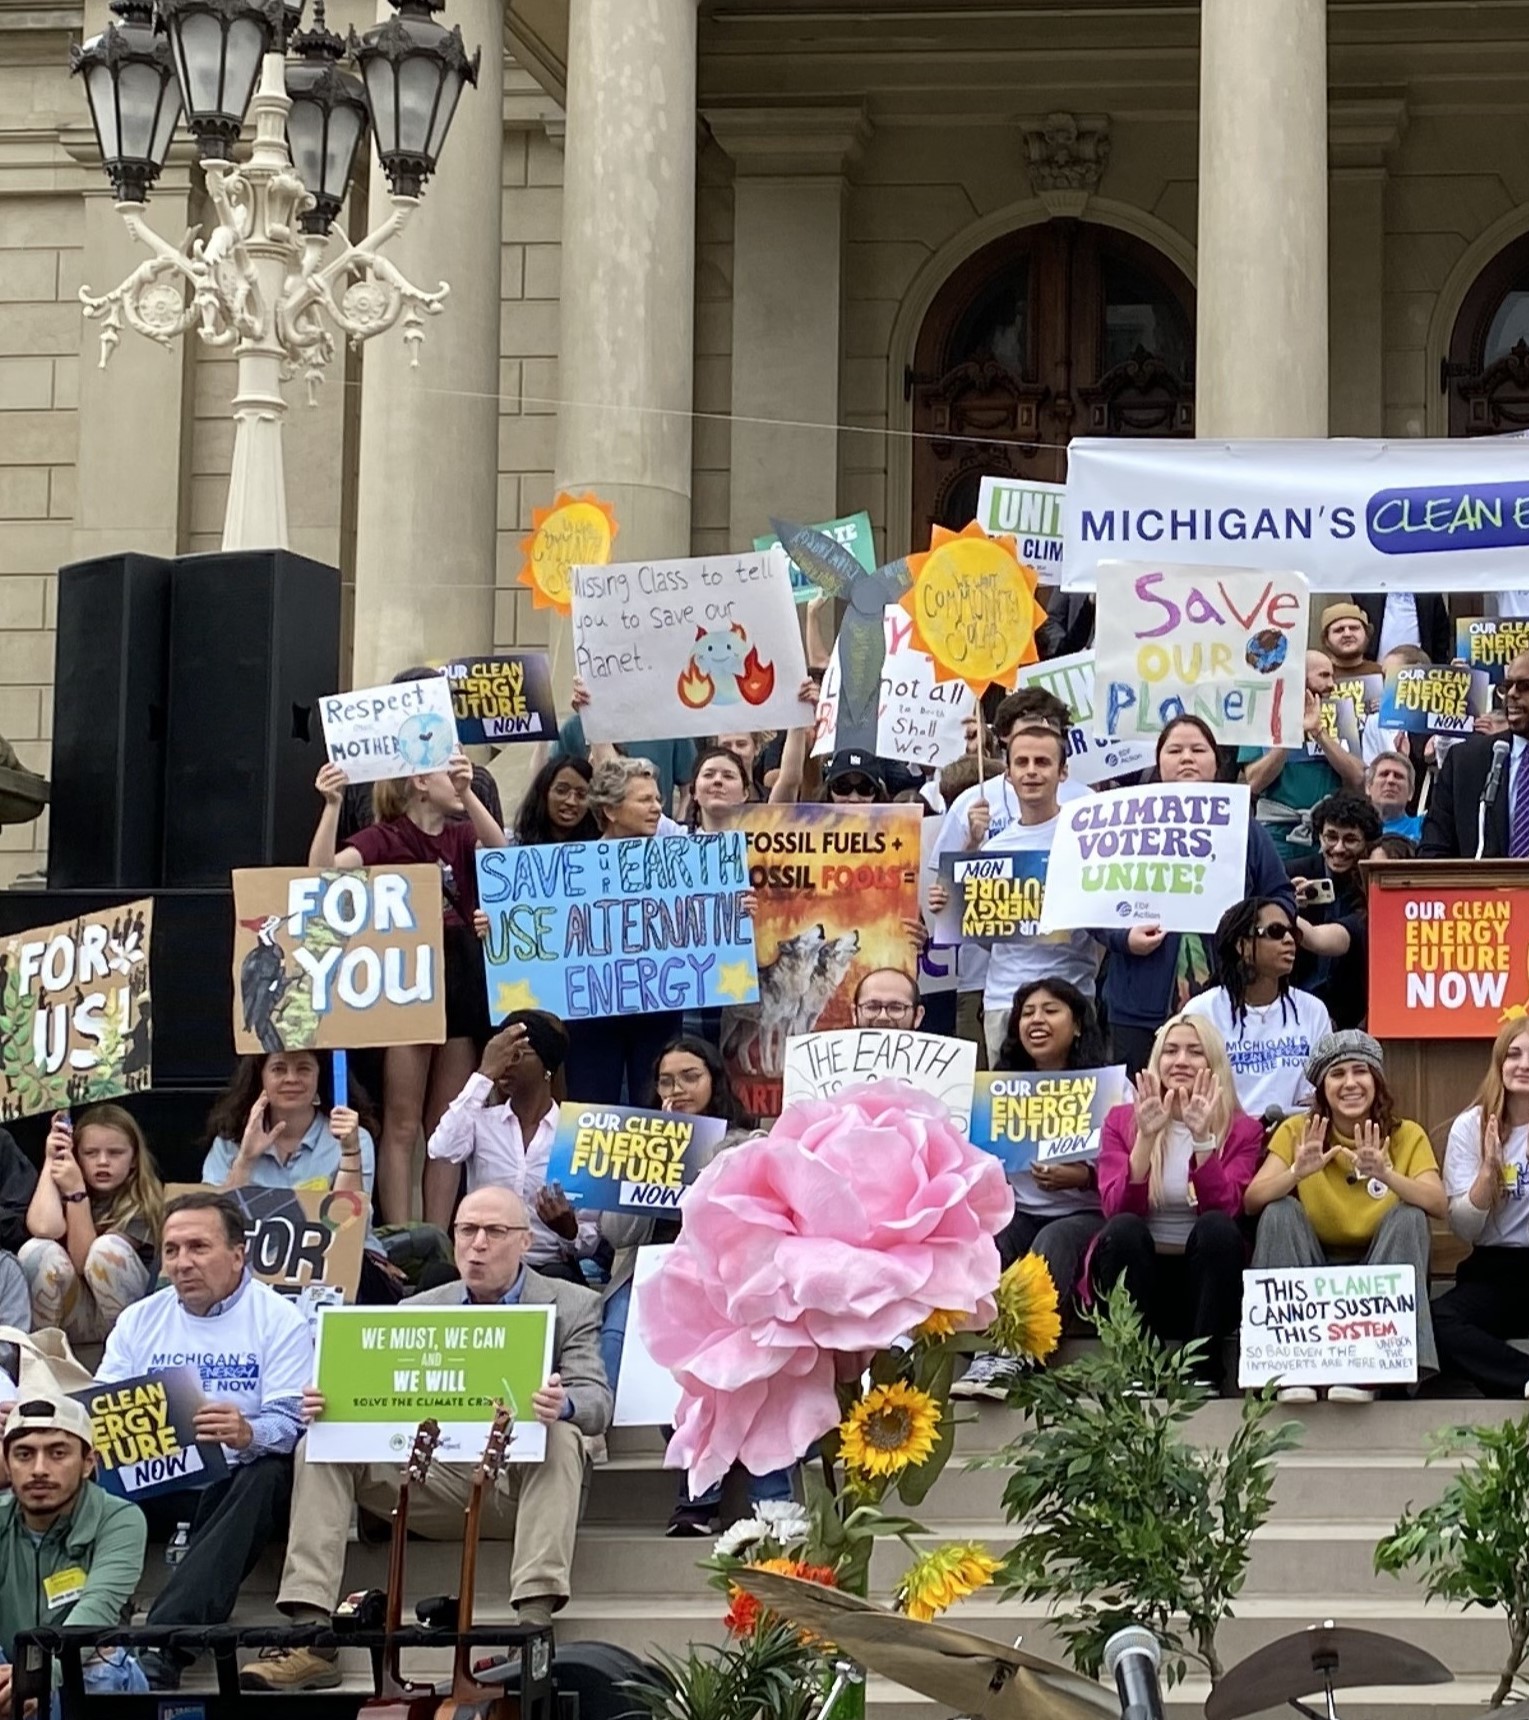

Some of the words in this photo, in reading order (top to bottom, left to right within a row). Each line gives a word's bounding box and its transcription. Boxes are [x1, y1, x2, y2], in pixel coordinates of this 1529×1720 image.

[1081, 506, 1355, 541] MICHIGAN'S
[1372, 494, 1502, 534] CLEAN
[638, 566, 689, 595] Class
[702, 571, 723, 586] to
[736, 557, 774, 583] tell
[577, 614, 607, 640] you
[621, 609, 640, 631] to
[705, 600, 736, 621] our
[472, 661, 523, 678] CLEAN
[1137, 642, 1233, 685] OUR
[1396, 680, 1469, 702] ENERGY
[1397, 669, 1426, 682] OUR
[1428, 669, 1471, 687] CLEAN
[1394, 695, 1468, 717] FUTURE
[493, 714, 533, 735] NOW
[1433, 713, 1470, 730] NOW
[1071, 796, 1231, 832] CLIMATE
[746, 832, 816, 854] FOSSIL
[823, 831, 886, 854] FUELS
[1078, 828, 1217, 863] VOTERS,
[481, 843, 587, 902] SAVE
[617, 832, 745, 893] EARTH
[822, 865, 901, 891] FOOLS
[1081, 862, 1207, 895] UNITE!
[287, 873, 415, 938] FOR
[1405, 901, 1446, 920] OUR
[1452, 901, 1511, 920] CLEAN
[488, 906, 559, 966] USE
[962, 921, 1016, 937] CLEAN
[1406, 920, 1510, 944] ENERGY
[19, 924, 111, 997] FOR
[1406, 945, 1511, 971] FUTURE
[292, 945, 432, 1013] YOU
[566, 953, 716, 1018] ENERGY
[1406, 971, 1509, 1008] NOW
[794, 1036, 848, 1080] THE
[853, 1032, 961, 1080] EARTH
[990, 1080, 1032, 1097] OUR
[1035, 1077, 1096, 1096] CLEAN
[992, 1093, 1096, 1121] ENERGY
[625, 1117, 694, 1141] CLEAN
[990, 1114, 1092, 1142] FUTURE
[576, 1129, 690, 1163] ENERGY
[1047, 1135, 1094, 1156] NOW
[570, 1151, 685, 1187] FUTURE
[630, 1185, 686, 1206] NOW
[1256, 1278, 1308, 1303] THIS
[1314, 1273, 1402, 1297] PLANET
[1249, 1302, 1330, 1326] CANNOT
[1334, 1295, 1415, 1320] SUSTAIN
[362, 1328, 389, 1350] WE
[390, 1327, 439, 1351] MUST,
[445, 1328, 469, 1349] WE
[473, 1327, 506, 1349] CAN
[1267, 1326, 1322, 1344] THIS
[1327, 1320, 1398, 1341] SYSTEM
[151, 1353, 257, 1366] MICHIGAN'S
[421, 1352, 442, 1366] AND
[1247, 1347, 1262, 1358] SO
[1266, 1346, 1290, 1357] BAD
[1293, 1346, 1322, 1357] EVEN
[1329, 1346, 1357, 1356] THE
[1247, 1359, 1318, 1371] INTROVERTS
[1322, 1358, 1344, 1368] ARE
[217, 1380, 257, 1391] NOW
[393, 1371, 419, 1392] WE
[425, 1370, 466, 1391] WILL
[92, 1382, 167, 1415] CLEAN
[391, 1397, 413, 1407] THE
[416, 1397, 464, 1407] CLIMATE
[134, 1447, 189, 1487] NOW
